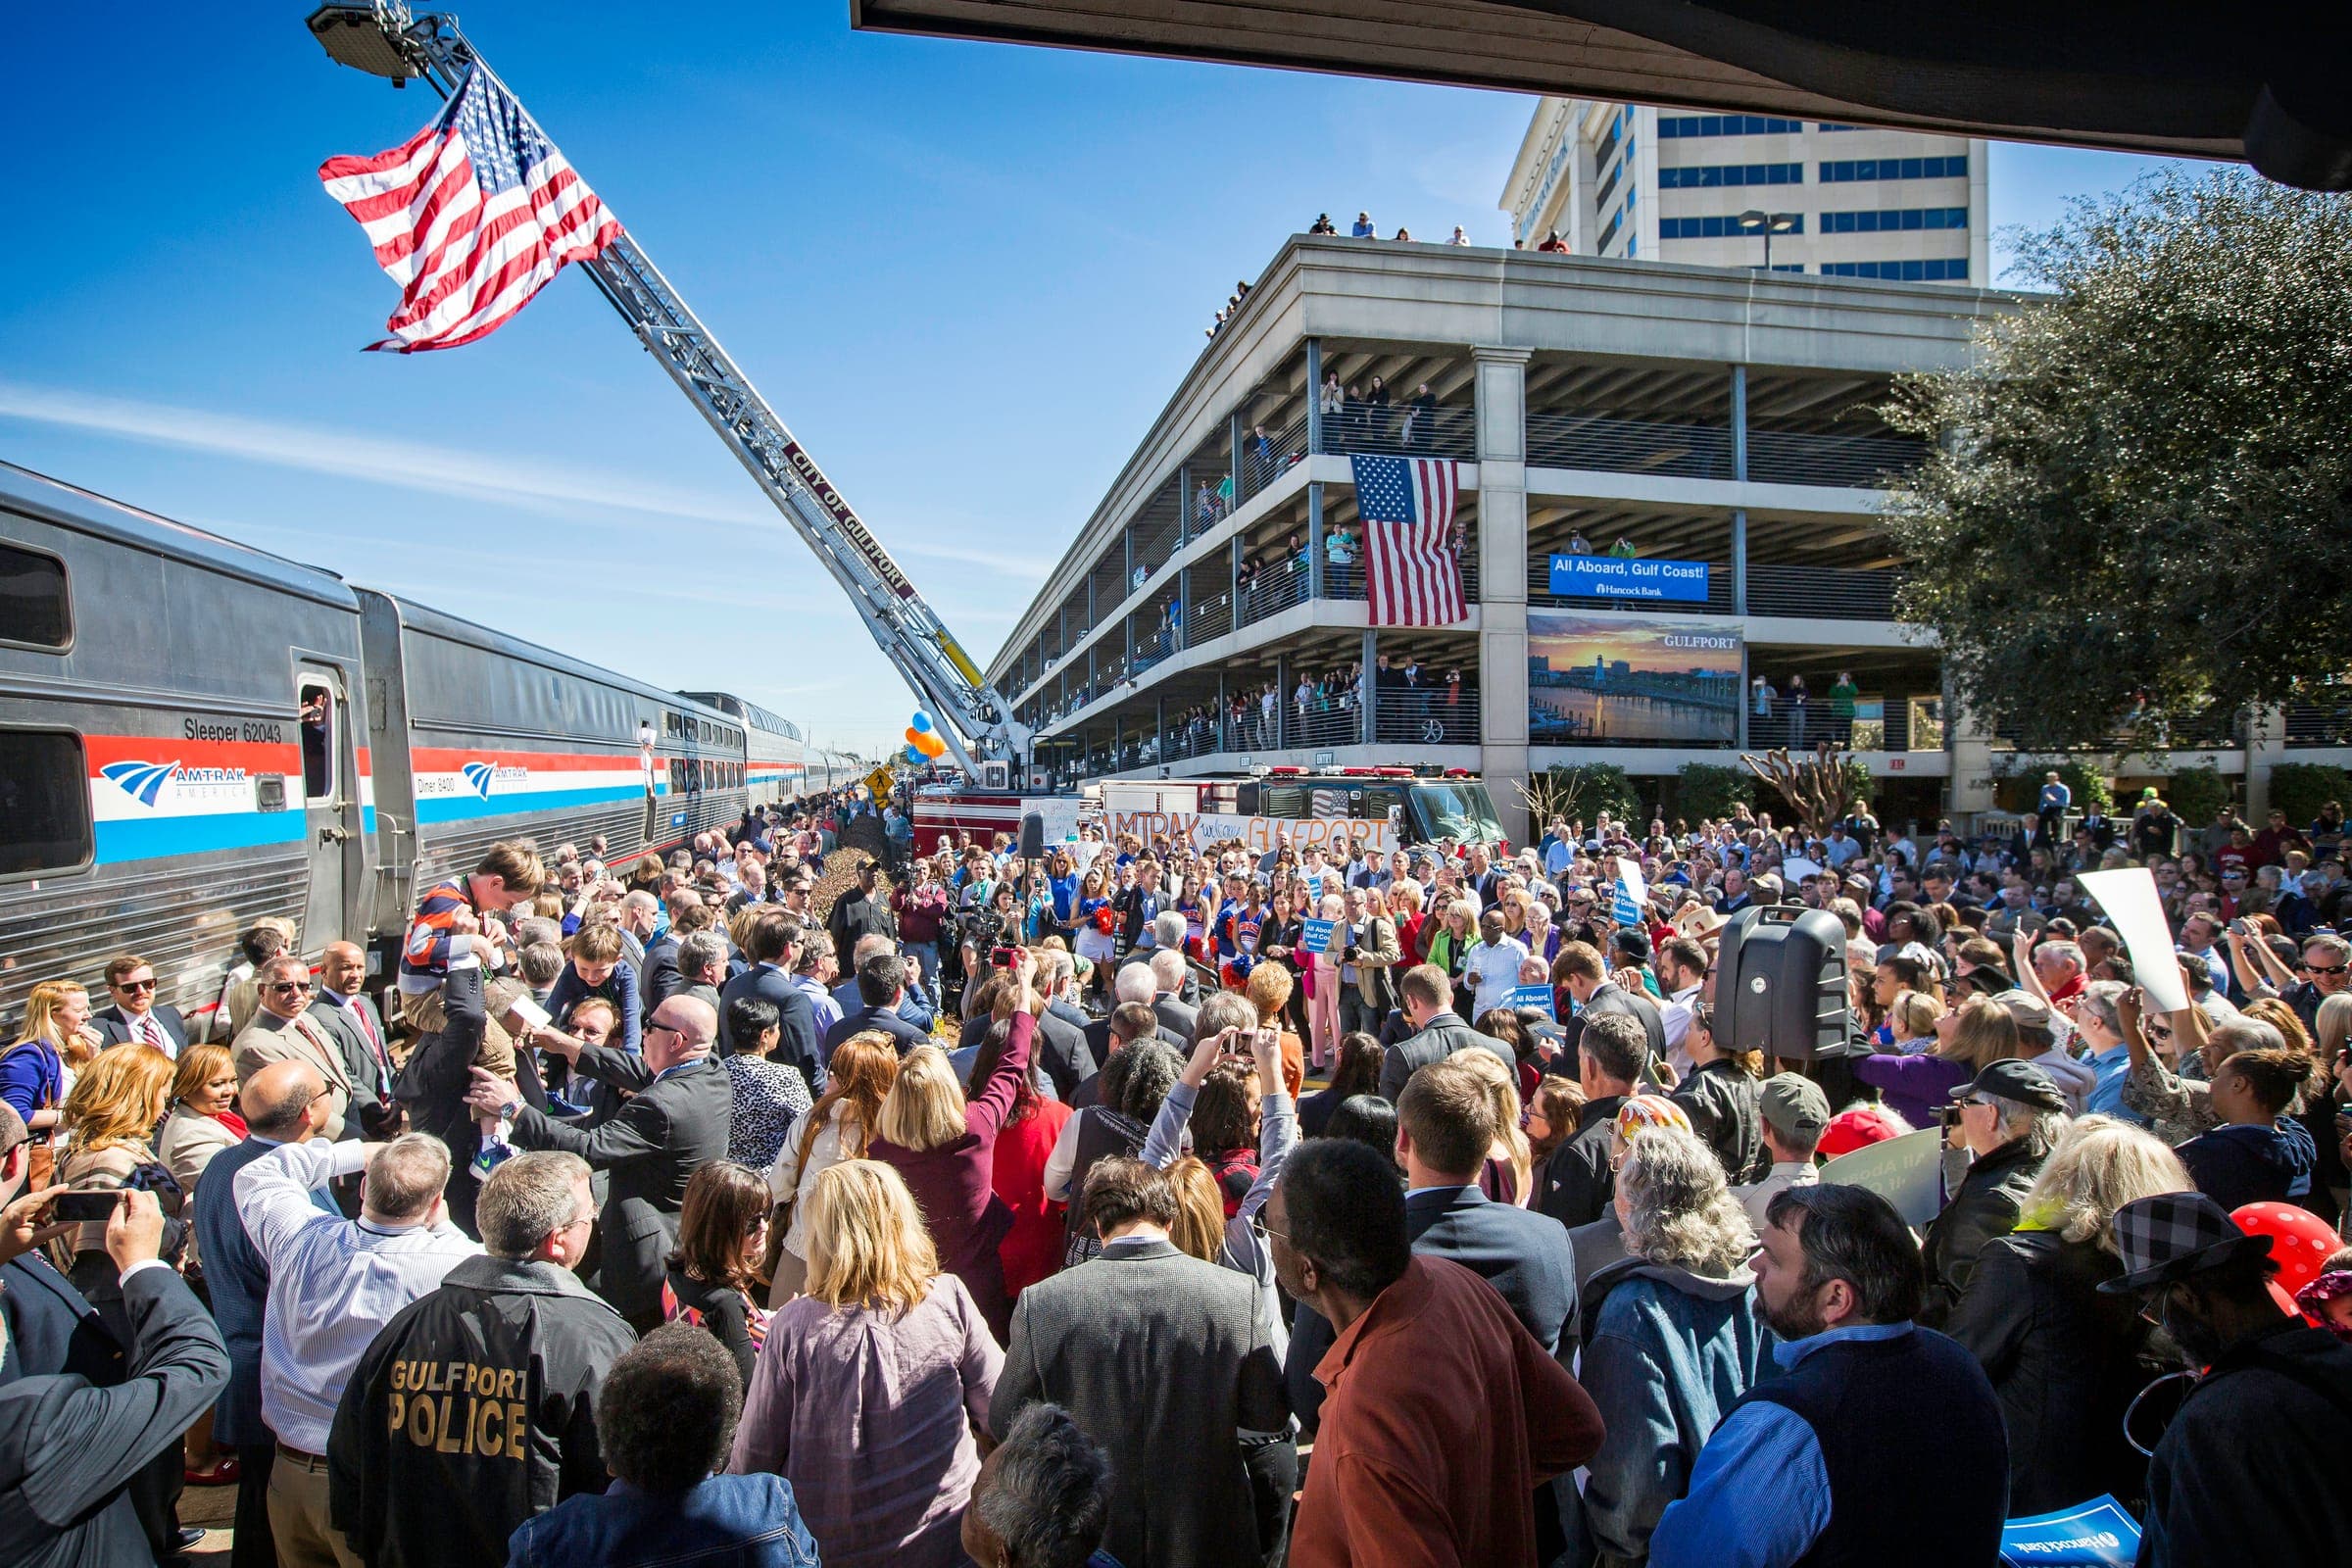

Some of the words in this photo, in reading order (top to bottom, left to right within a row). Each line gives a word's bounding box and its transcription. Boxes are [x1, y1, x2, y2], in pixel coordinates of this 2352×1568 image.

[792, 452, 826, 488] CITY
[823, 491, 849, 513] OF
[845, 515, 908, 588] GULFPORT
[1554, 560, 1572, 571] All
[1576, 561, 1628, 576] Aboard,
[1632, 564, 1658, 576] Gulf
[1663, 564, 1704, 578] Coast!
[1605, 585, 1641, 596] Hancock
[1642, 587, 1662, 596] Bank
[1664, 635, 1737, 649] GULFPORT
[184, 717, 238, 746] Sleeper
[243, 722, 281, 744] 62043
[175, 769, 246, 782] AMTRAK
[494, 768, 527, 779] AMTRAK
[417, 778, 436, 793] Diner
[438, 777, 455, 792] 8400
[1102, 812, 1200, 857] AMTRAK
[1315, 925, 1332, 934] Aboa
[1525, 994, 1550, 1003] Aboard,
[389, 1360, 528, 1401] GULFPORT
[388, 1393, 525, 1461] POLICE
[2017, 1542, 2052, 1553] Bank
[2051, 1534, 2101, 1552] Hancock
